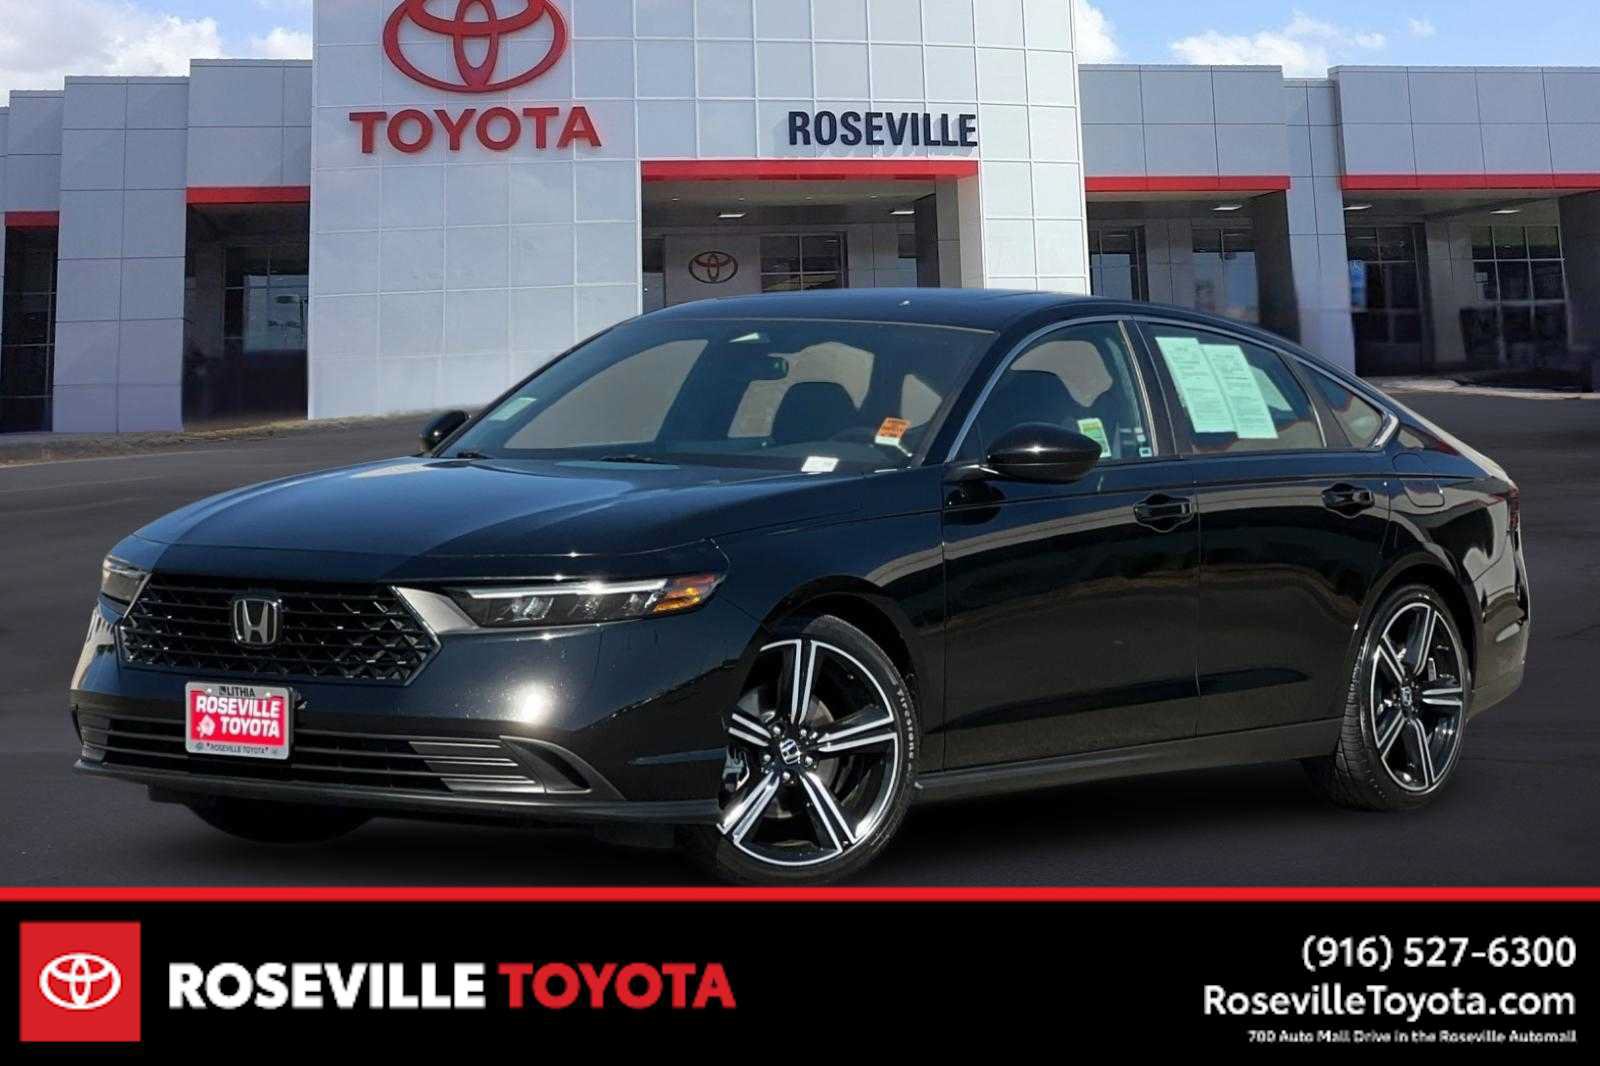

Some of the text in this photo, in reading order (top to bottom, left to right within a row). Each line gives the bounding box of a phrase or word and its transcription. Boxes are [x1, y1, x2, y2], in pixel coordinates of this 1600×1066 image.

[350, 106, 602, 154] TOYOTA
[788, 111, 978, 147] ROSEVILLE
[226, 685, 256, 697] LITHIA
[196, 696, 281, 718] ROSEVILLE
[220, 716, 280, 738] TOYOTA
